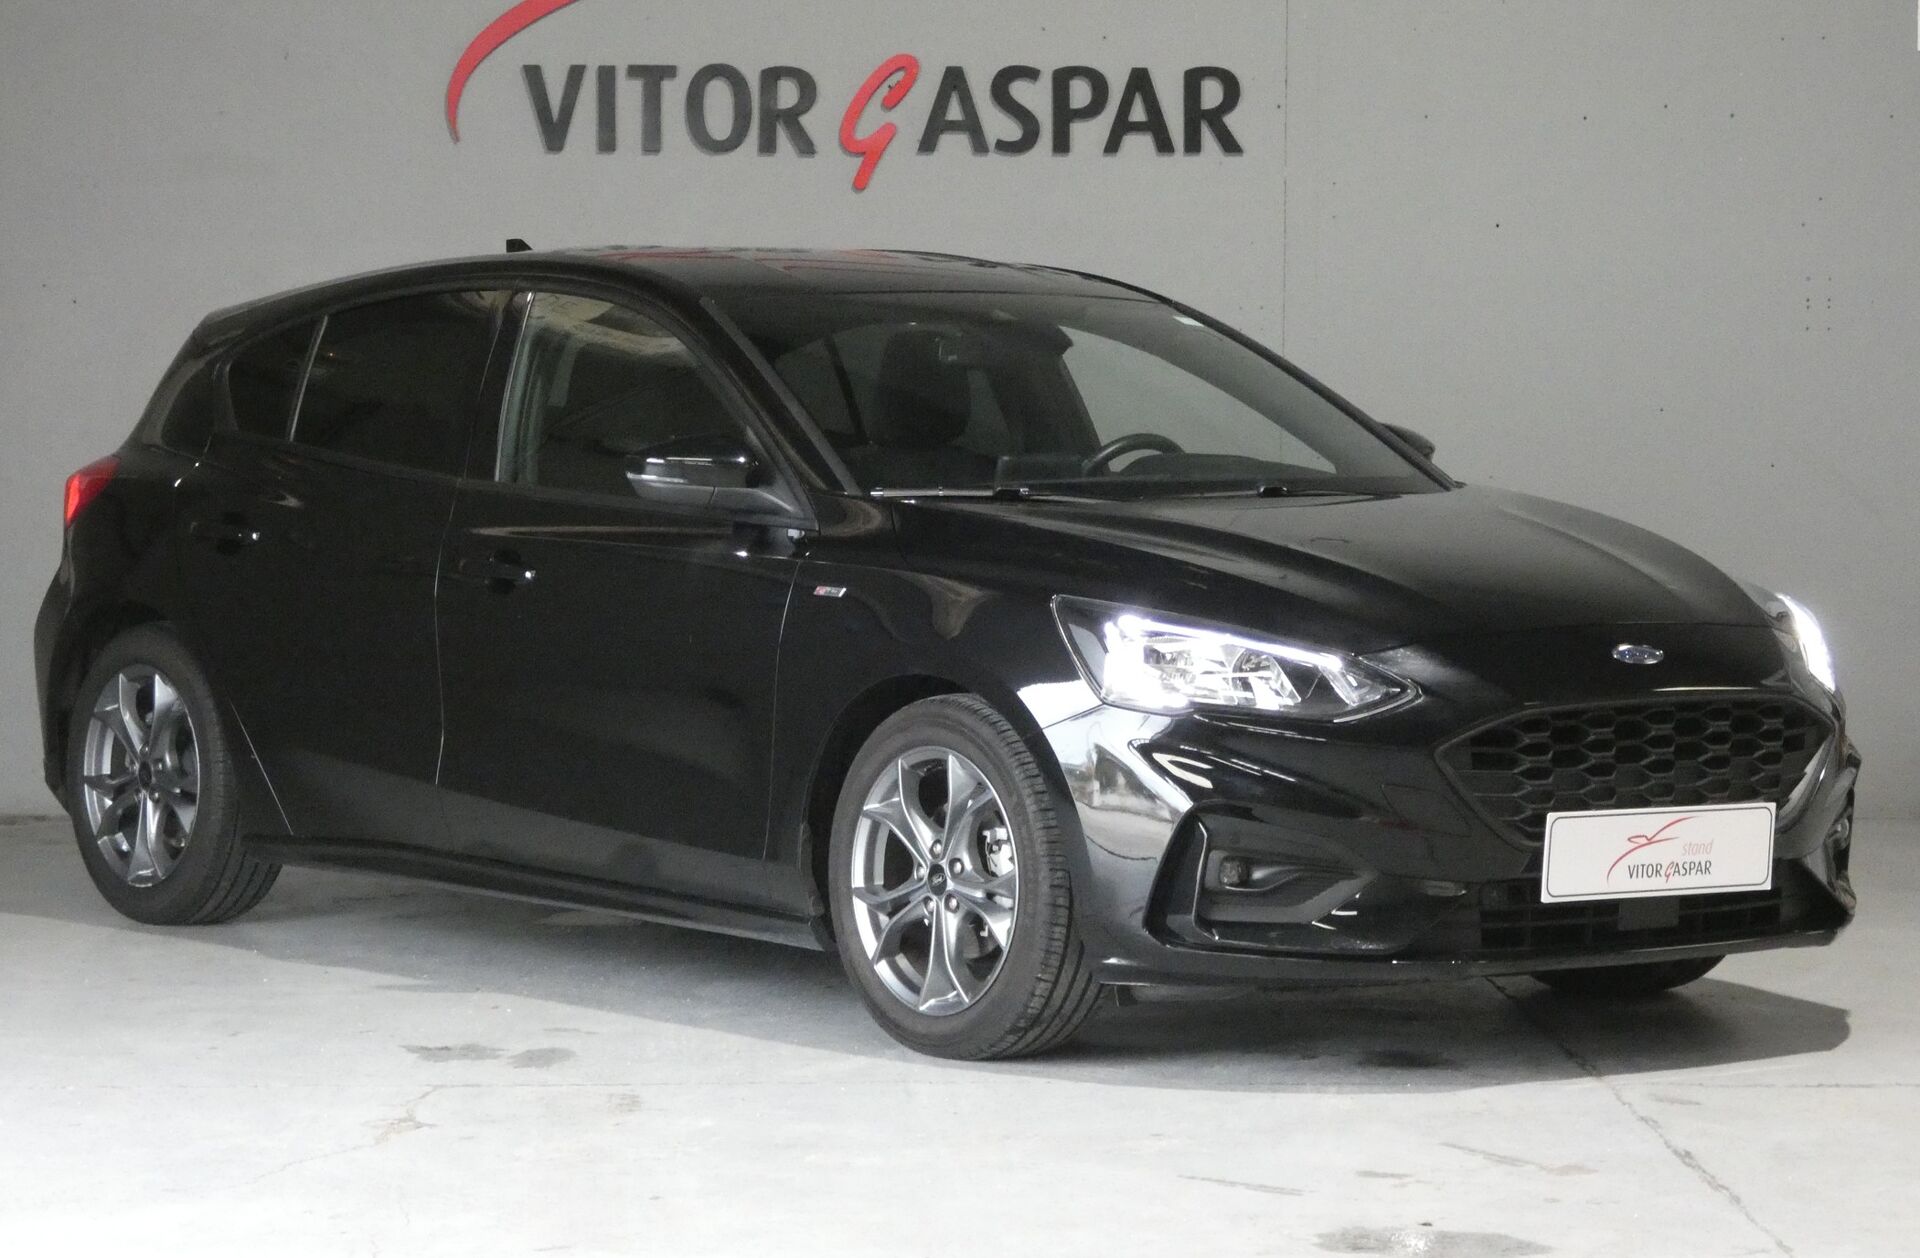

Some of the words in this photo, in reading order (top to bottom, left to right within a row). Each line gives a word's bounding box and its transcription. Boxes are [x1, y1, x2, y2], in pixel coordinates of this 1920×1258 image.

[522, 63, 818, 156] VITOR
[838, 53, 1244, 192] GASPAR
[1682, 838, 1714, 856] stand
[1628, 862, 1663, 880] VITOR
[1664, 859, 1712, 884] GASPAR
